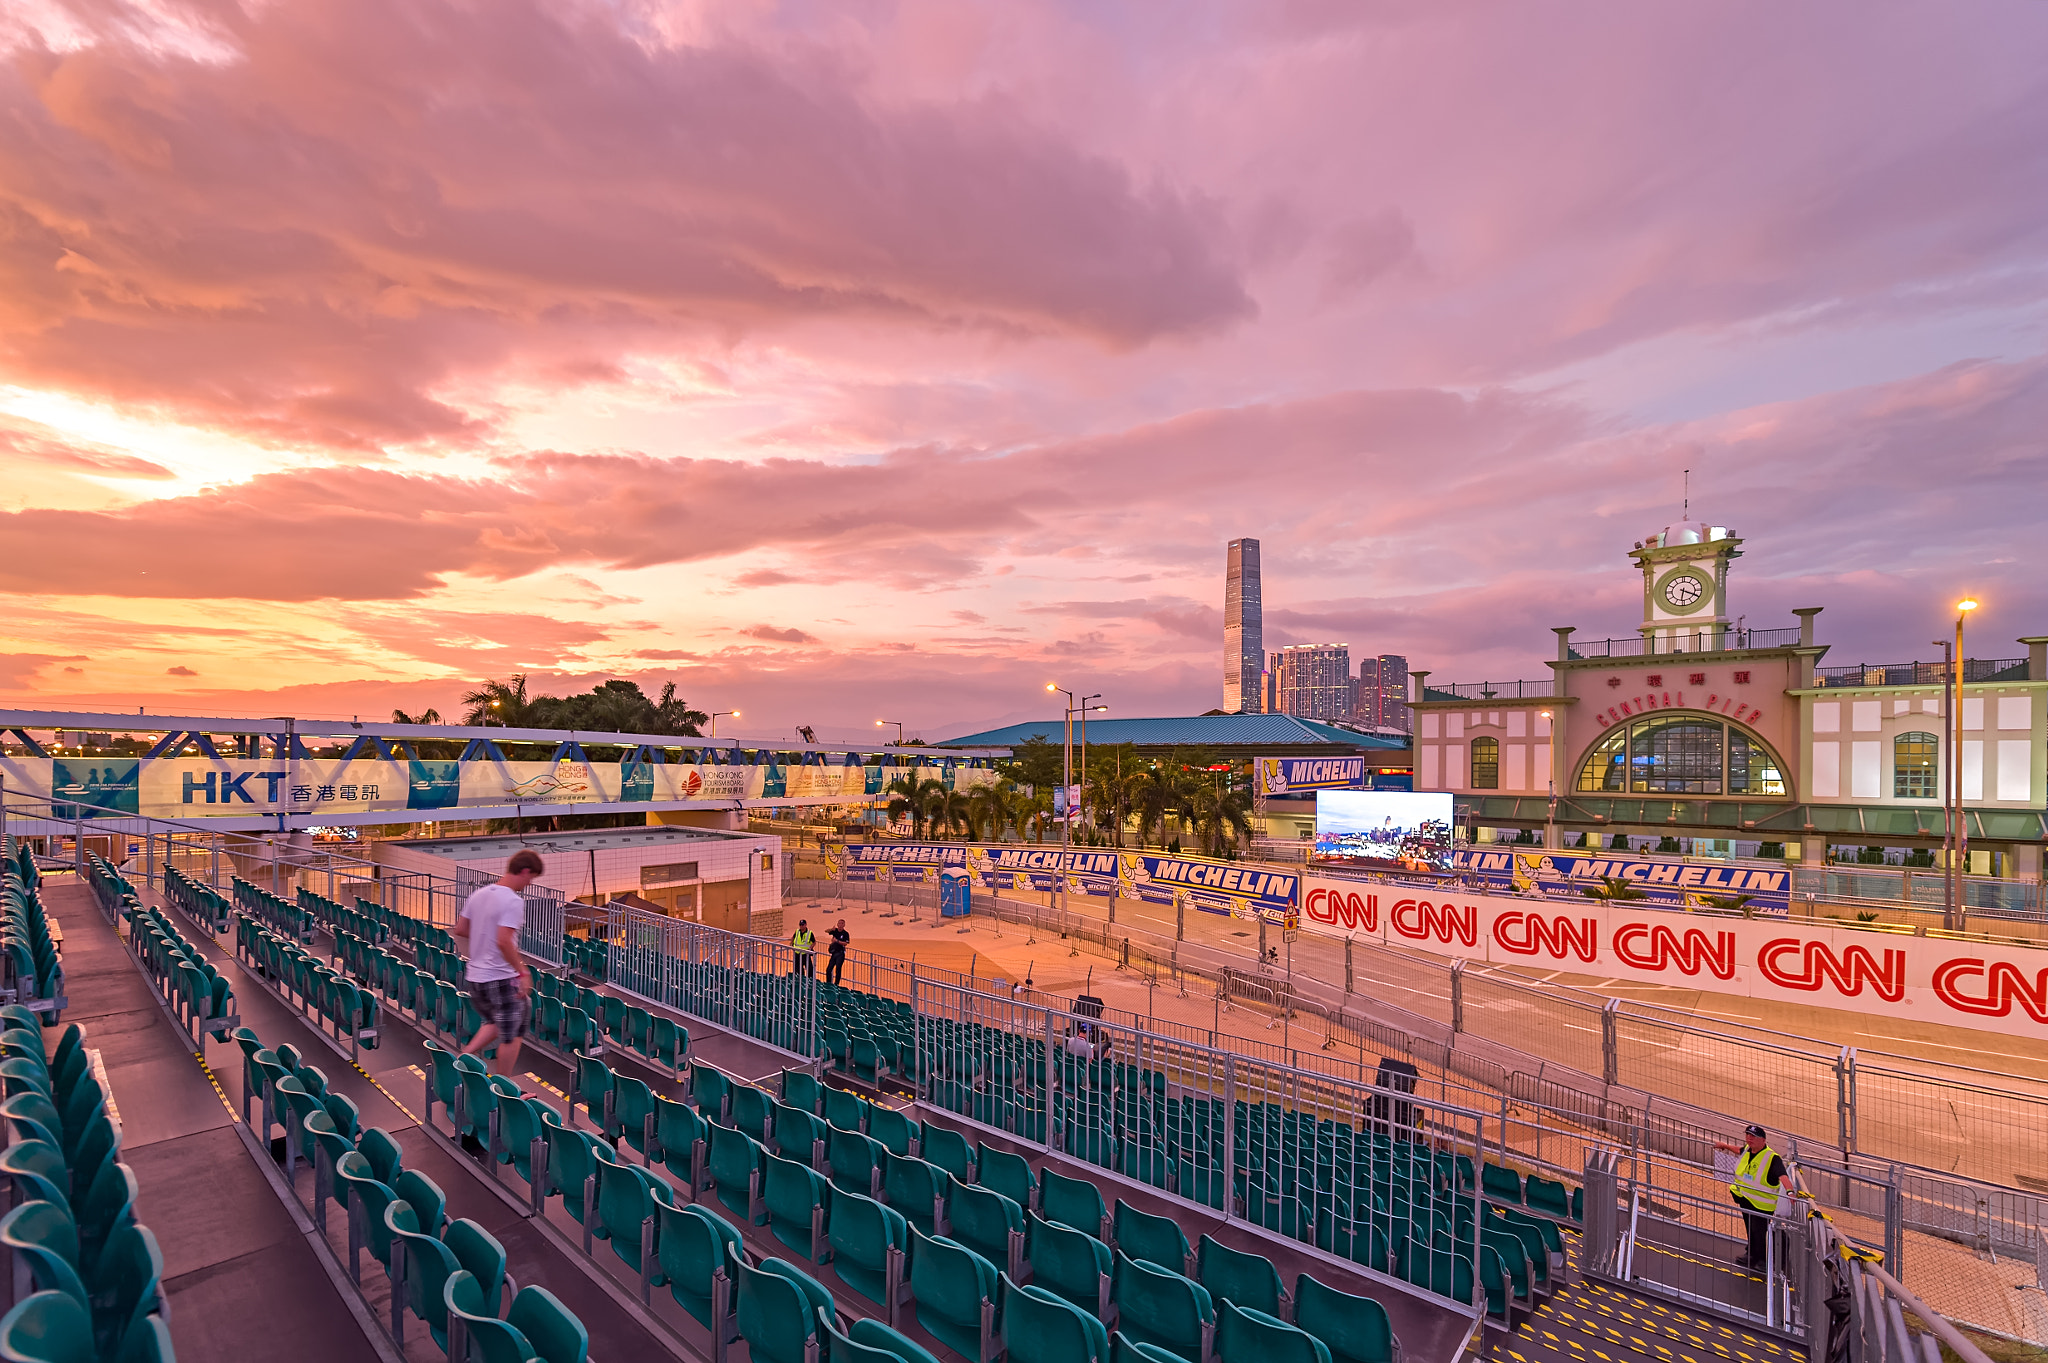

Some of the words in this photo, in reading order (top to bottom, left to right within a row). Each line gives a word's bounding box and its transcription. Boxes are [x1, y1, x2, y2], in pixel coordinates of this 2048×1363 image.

[1607, 671, 1750, 689] 中環碼頭
[1597, 692, 1684, 727] CENTRAL
[1706, 694, 1762, 724] PIER
[703, 771, 724, 779] HONG
[1291, 761, 1361, 783] MICHELIN
[183, 772, 291, 803] HKT
[290, 784, 379, 802] 香港電訊
[860, 846, 964, 863] MICHELIN
[1000, 851, 1115, 872] MICHELIN
[1155, 860, 1294, 897] MICHELIN
[1570, 860, 1785, 891] MICHELIN
[1306, 889, 1377, 932] CNN
[1391, 900, 1477, 947] CNN
[1493, 912, 1597, 962] CNN
[1613, 923, 1735, 980] CNN
[1758, 938, 1905, 1002] CNN
[1932, 958, 2048, 1024] CN
